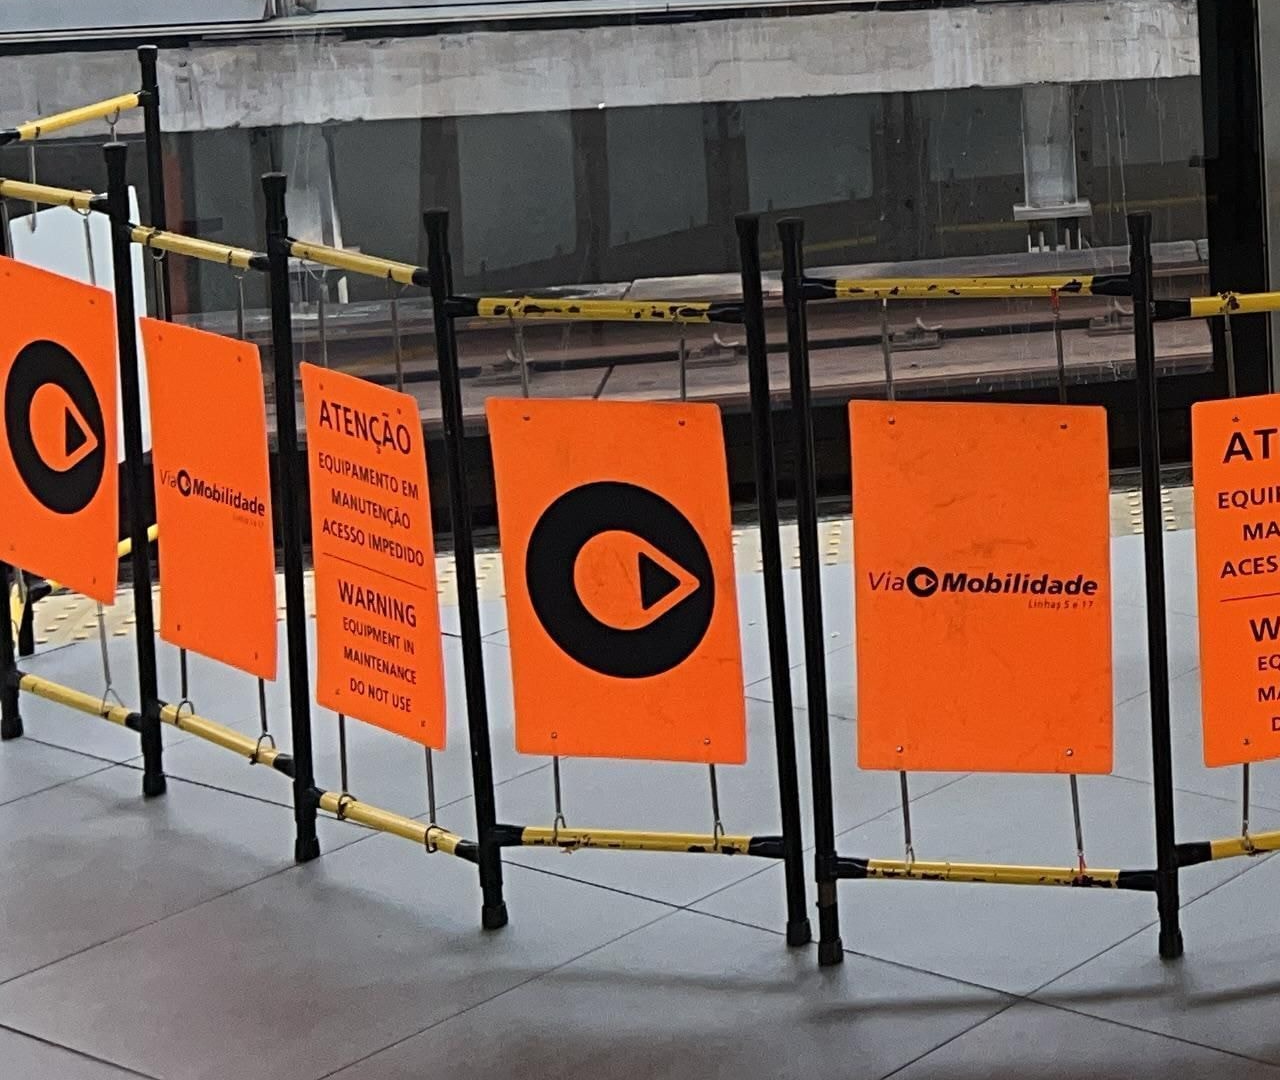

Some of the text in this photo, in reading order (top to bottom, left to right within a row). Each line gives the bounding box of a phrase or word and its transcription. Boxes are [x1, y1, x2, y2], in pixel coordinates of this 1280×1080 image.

[318, 399, 412, 455] ATENÇÃO
[193, 478, 265, 517] Mobilidade
[319, 452, 418, 500] EQUIPAMENTO EM
[331, 488, 410, 529] MANUTENÇÃO
[322, 517, 425, 567] ACESSO IMPEDIDO
[338, 579, 417, 628] WARNING
[868, 572, 1098, 596] Via Mobilidade
